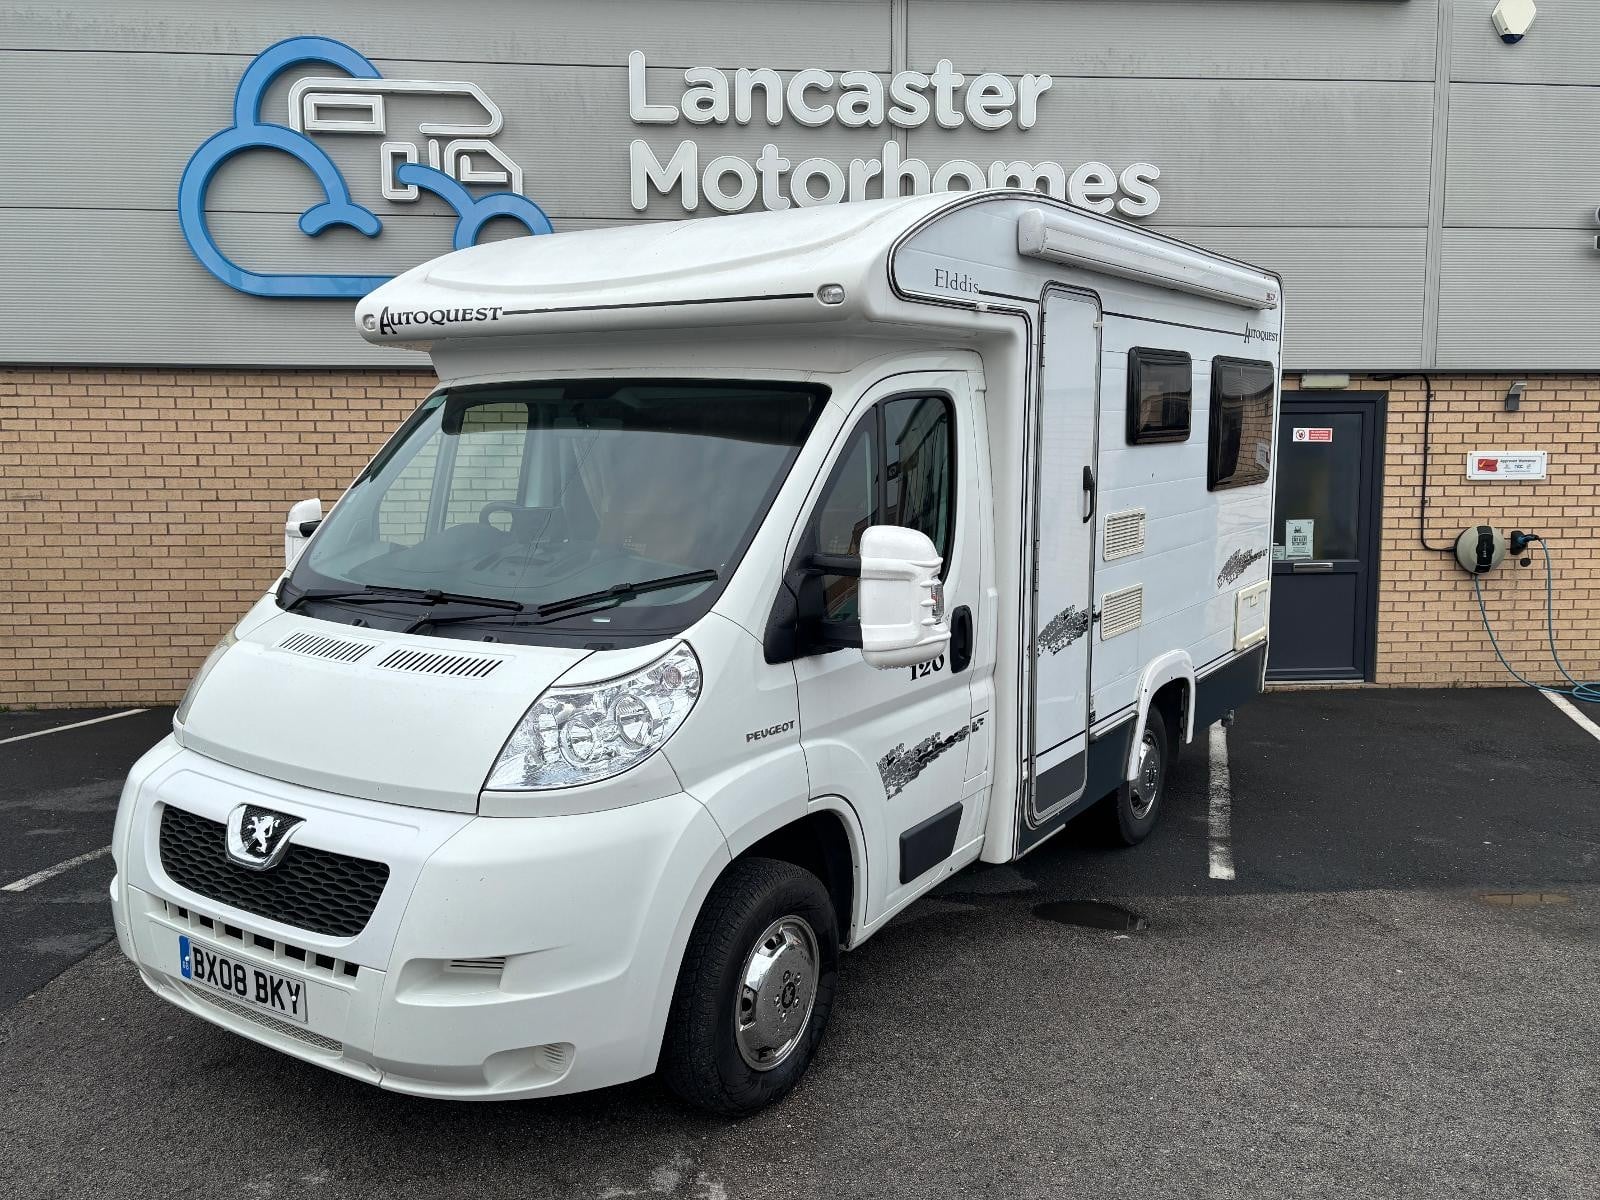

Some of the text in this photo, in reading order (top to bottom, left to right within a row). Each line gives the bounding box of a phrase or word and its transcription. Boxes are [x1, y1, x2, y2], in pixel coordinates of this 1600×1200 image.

[628, 50, 1053, 131] Lancaster
[629, 140, 1161, 217] Motorhomes
[934, 268, 979, 293] Elddis
[379, 306, 503, 335] AUTOQUEST
[1243, 322, 1279, 344] AUTOQUEST
[910, 653, 945, 681] 120
[746, 720, 795, 743] PEUGEOT
[192, 946, 300, 1015] BX08 BKY
